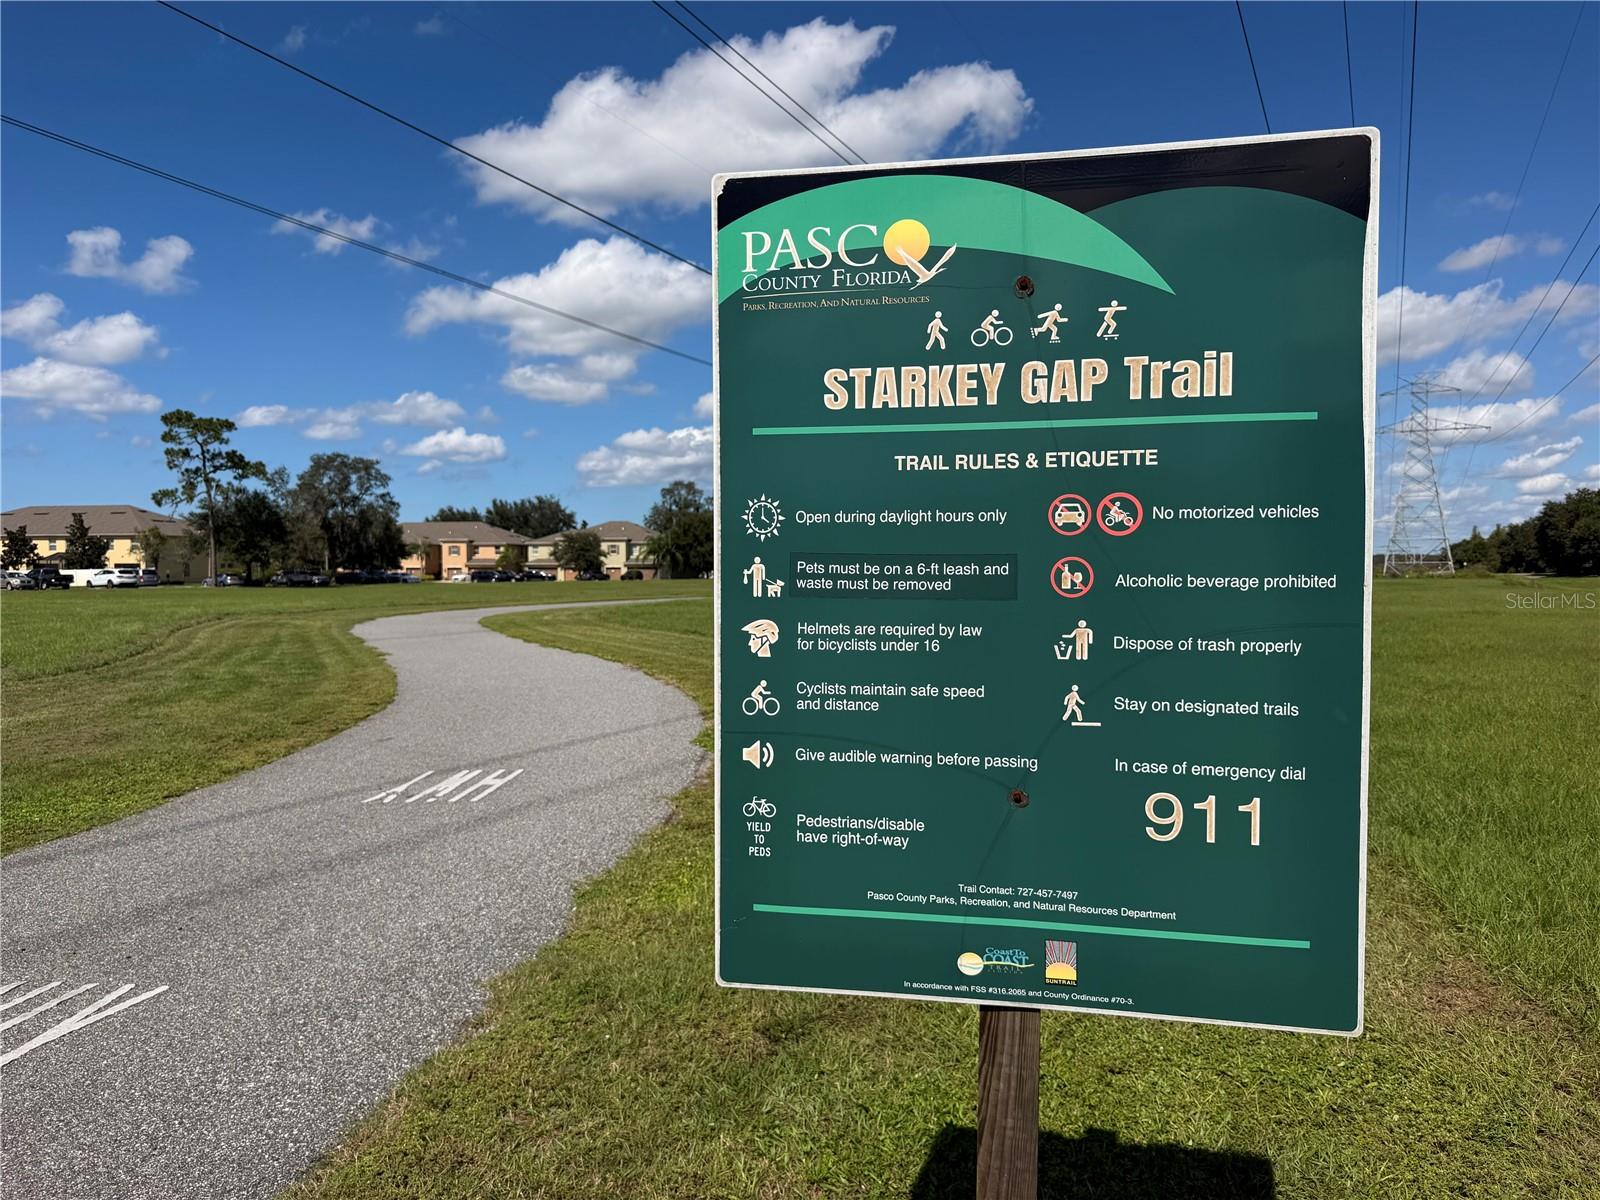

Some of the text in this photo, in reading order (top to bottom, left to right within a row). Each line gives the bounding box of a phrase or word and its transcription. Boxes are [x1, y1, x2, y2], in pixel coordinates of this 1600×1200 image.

[742, 269, 911, 292] COUNTY FLORIDA
[841, 297, 881, 307] NATURAL
[882, 295, 930, 305] RESOURCES
[823, 350, 1234, 410] STARKEY GAP Trail
[895, 449, 1159, 471] TRAIL RULES & ETIQUETTE
[795, 509, 1007, 525] Open during daylight hours only
[1152, 504, 1320, 520] No motorized vehicles
[797, 561, 1009, 576] Pets must be on a 6-ft leash and
[796, 578, 951, 591] waste must be removed
[1115, 574, 1337, 592] Alcoholic beverage prohibited
[798, 623, 983, 639] Helmets are required by law
[797, 638, 940, 653] for bicyclists under 16
[1113, 636, 1302, 657] Dispose of trash properly
[796, 681, 985, 701] Cyclists maintain safe speed
[796, 698, 879, 711] and distance
[1114, 697, 1299, 717] Stay on designated trails
[795, 749, 1038, 772] Give audible warning before passing
[1115, 758, 1306, 782] In case of emergency dial
[747, 822, 771, 832] YIELD
[797, 814, 925, 832] Pedestrians/disable
[1144, 792, 1260, 846] 911
[754, 835, 765, 844] TO
[796, 831, 909, 850] have right-of-way
[749, 847, 771, 857] PEDS
[958, 883, 1078, 900] Trail Contact: 727-457-7497
[867, 891, 1177, 920] Pasco County Parks, Recreation, and Natural Resources Department
[912, 982, 953, 991] accordance
[954, 984, 969, 992] with
[970, 985, 987, 993] FSS
[1028, 989, 1042, 997] and
[1043, 991, 1069, 1000] County
[1071, 993, 1109, 1003] Ordinance
